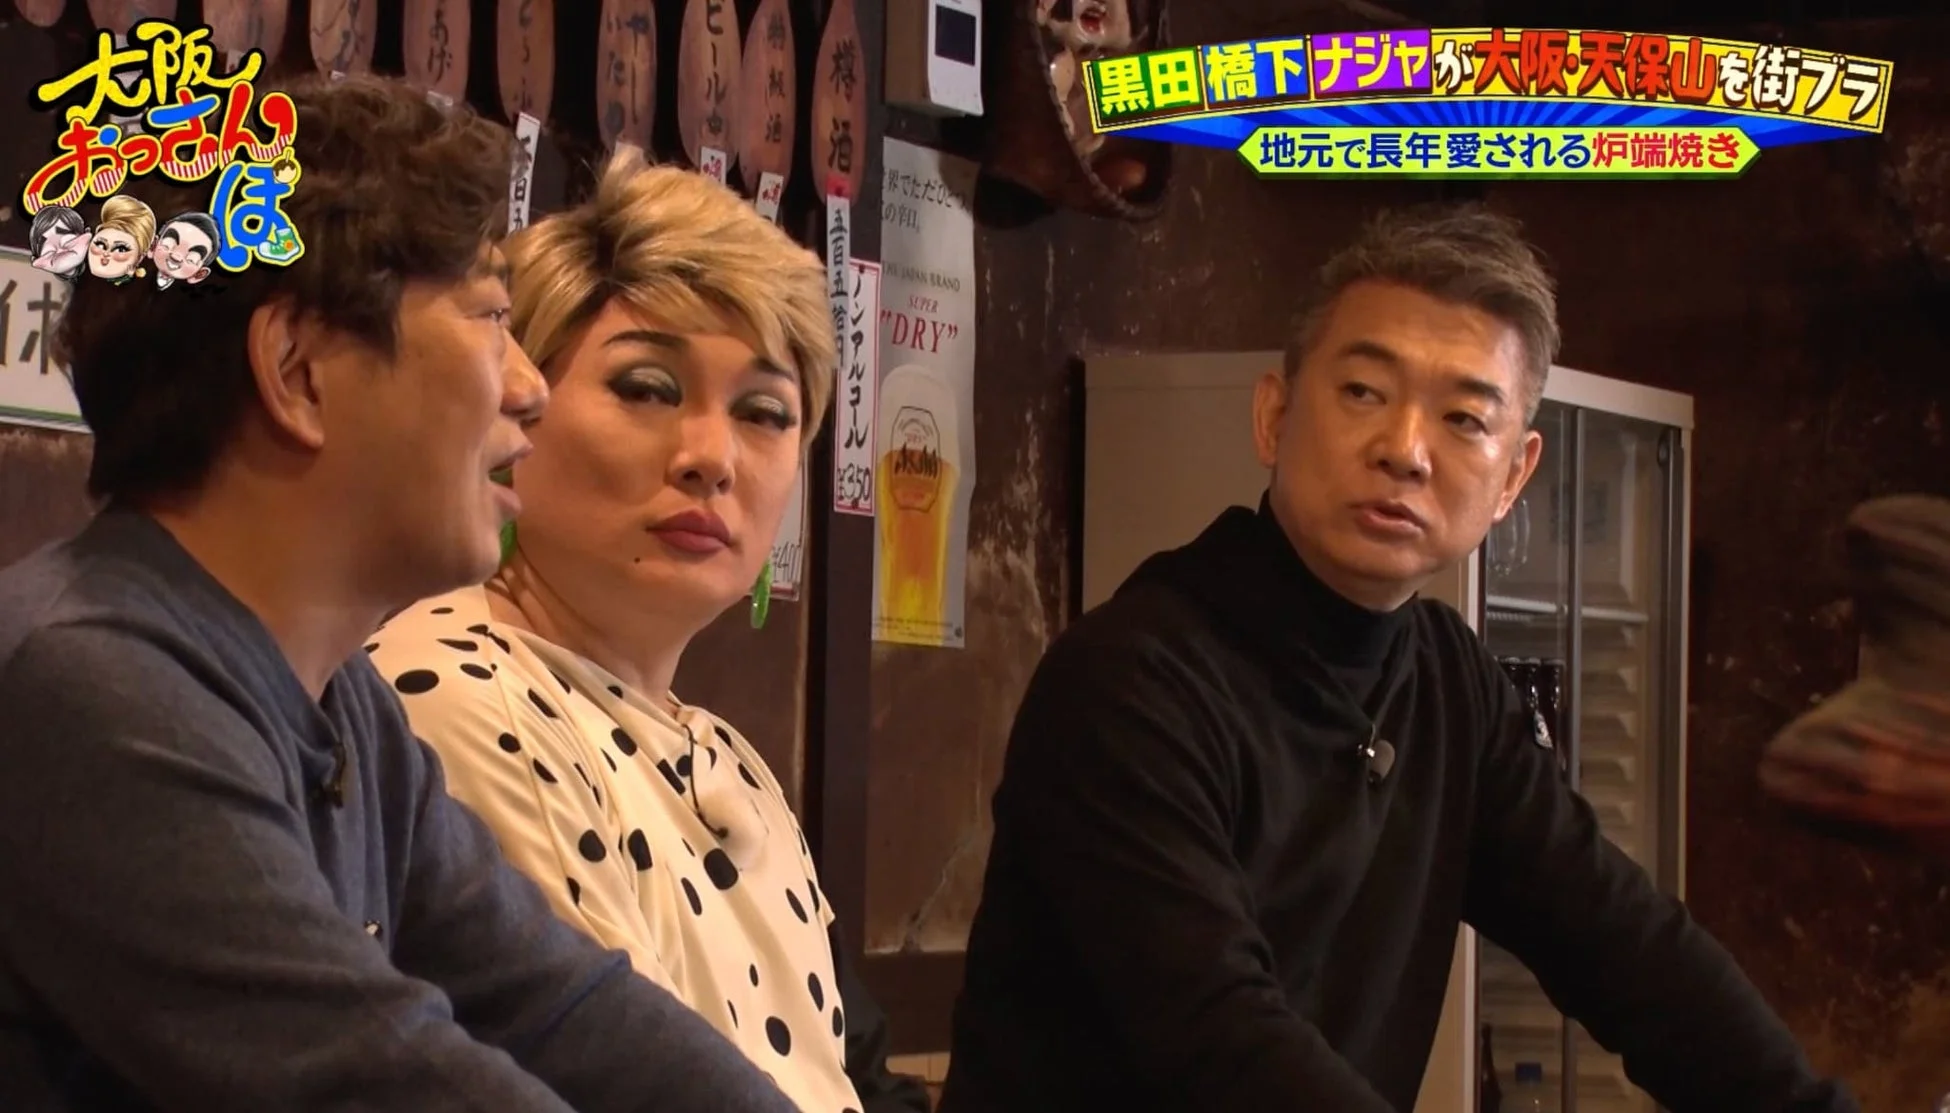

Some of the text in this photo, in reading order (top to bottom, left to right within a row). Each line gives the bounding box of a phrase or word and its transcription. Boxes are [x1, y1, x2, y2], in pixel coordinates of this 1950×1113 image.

[828, 38, 857, 173] 樽酒
[901, 266, 928, 285] JAPAN
[929, 271, 961, 292] BRAND
[908, 294, 939, 313] SUPER
[844, 274, 868, 450] ノンアルコール
